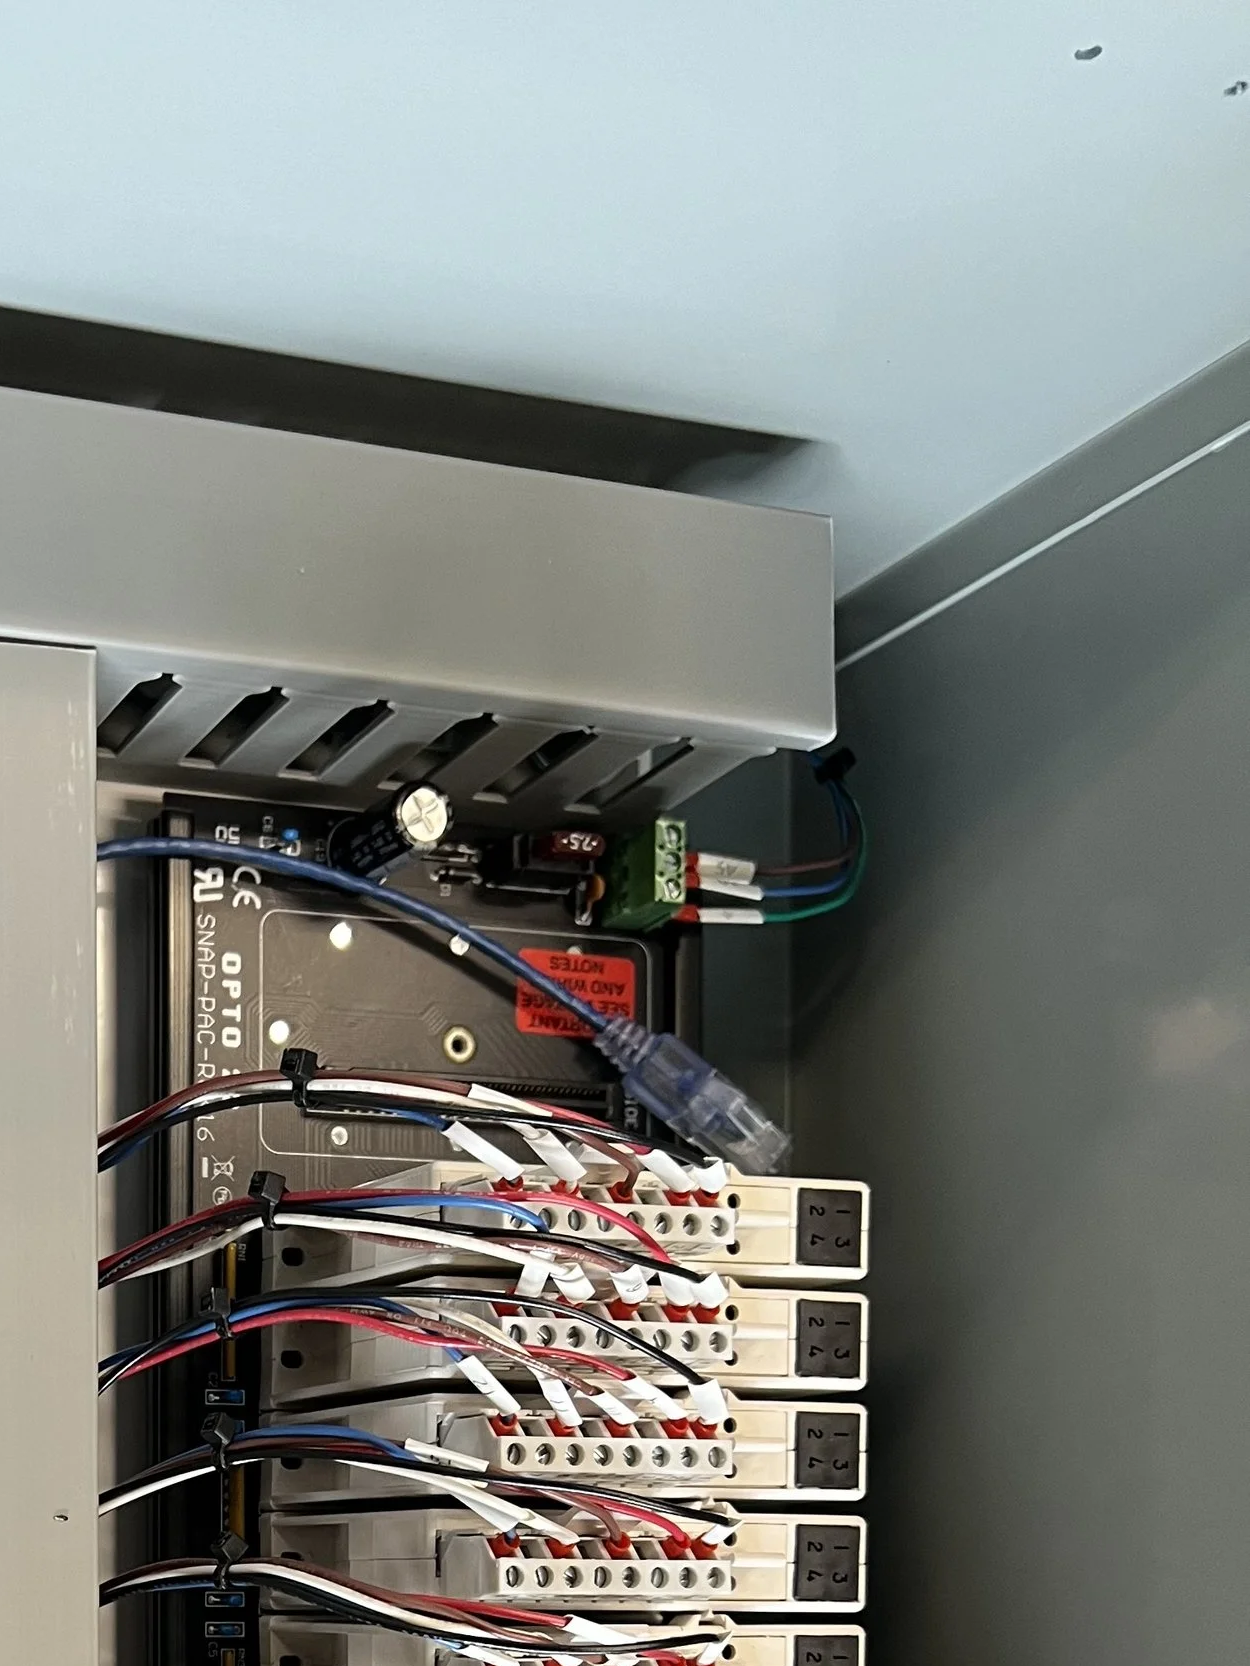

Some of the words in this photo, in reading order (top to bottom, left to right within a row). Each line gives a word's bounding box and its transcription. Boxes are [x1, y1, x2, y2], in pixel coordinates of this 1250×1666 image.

[232, 866, 261, 909] CE
[549, 957, 605, 975] NOTES
[222, 952, 241, 1047] OPTO
[809, 1205, 825, 1216] 2
[810, 1234, 824, 1246] 4
[835, 1237, 850, 1248] 3
[809, 1317, 824, 1327] 2
[809, 1345, 824, 1358] 4
[834, 1348, 849, 1360] 3
[807, 1428, 823, 1439] 2
[808, 1457, 823, 1469] 4
[833, 1459, 848, 1470] 3
[807, 1541, 823, 1552] 2
[807, 1570, 823, 1582] 4
[832, 1572, 848, 1584] 3
[807, 1652, 822, 1663] 2
